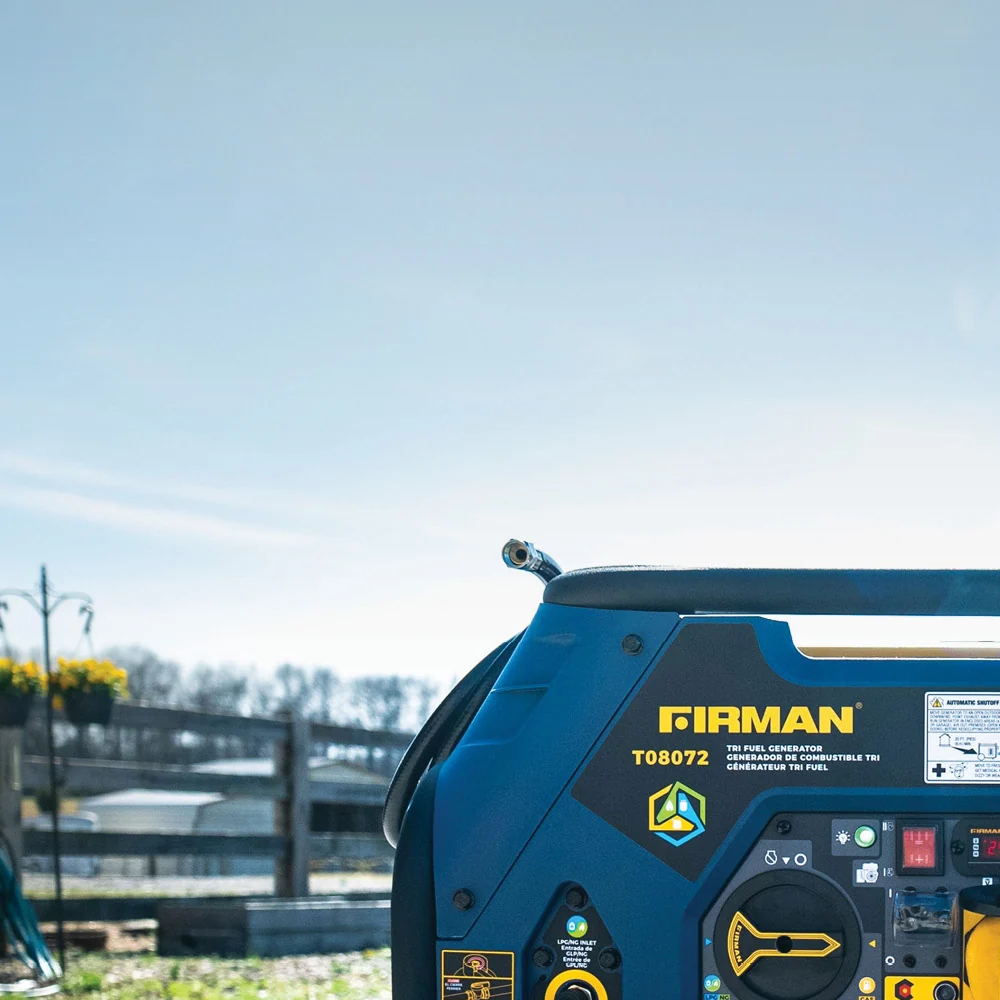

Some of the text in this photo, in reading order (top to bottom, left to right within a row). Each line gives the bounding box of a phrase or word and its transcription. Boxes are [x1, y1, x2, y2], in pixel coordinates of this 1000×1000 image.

[659, 706, 853, 734] FIRMAN
[632, 750, 709, 765] T08072
[726, 762, 786, 770] GÉNÉRATEUR
[732, 924, 743, 963] FIRMAN
